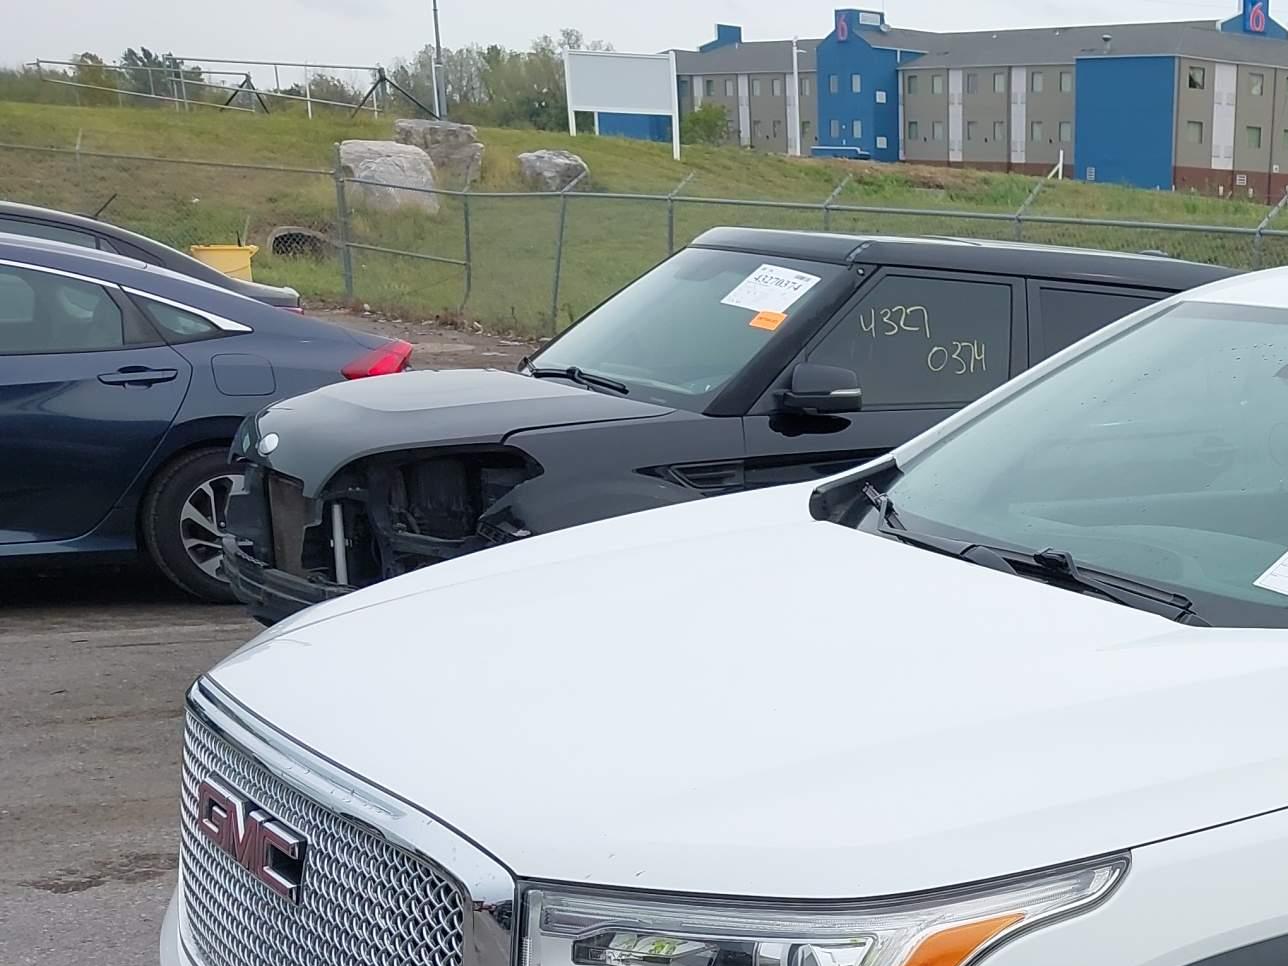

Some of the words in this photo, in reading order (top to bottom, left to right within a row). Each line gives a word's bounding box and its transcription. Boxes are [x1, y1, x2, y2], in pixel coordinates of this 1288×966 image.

[1250, 1, 1265, 32] 6
[860, 306, 930, 338] 4327
[928, 340, 986, 374] 0374
[199, 777, 302, 906] GMC
